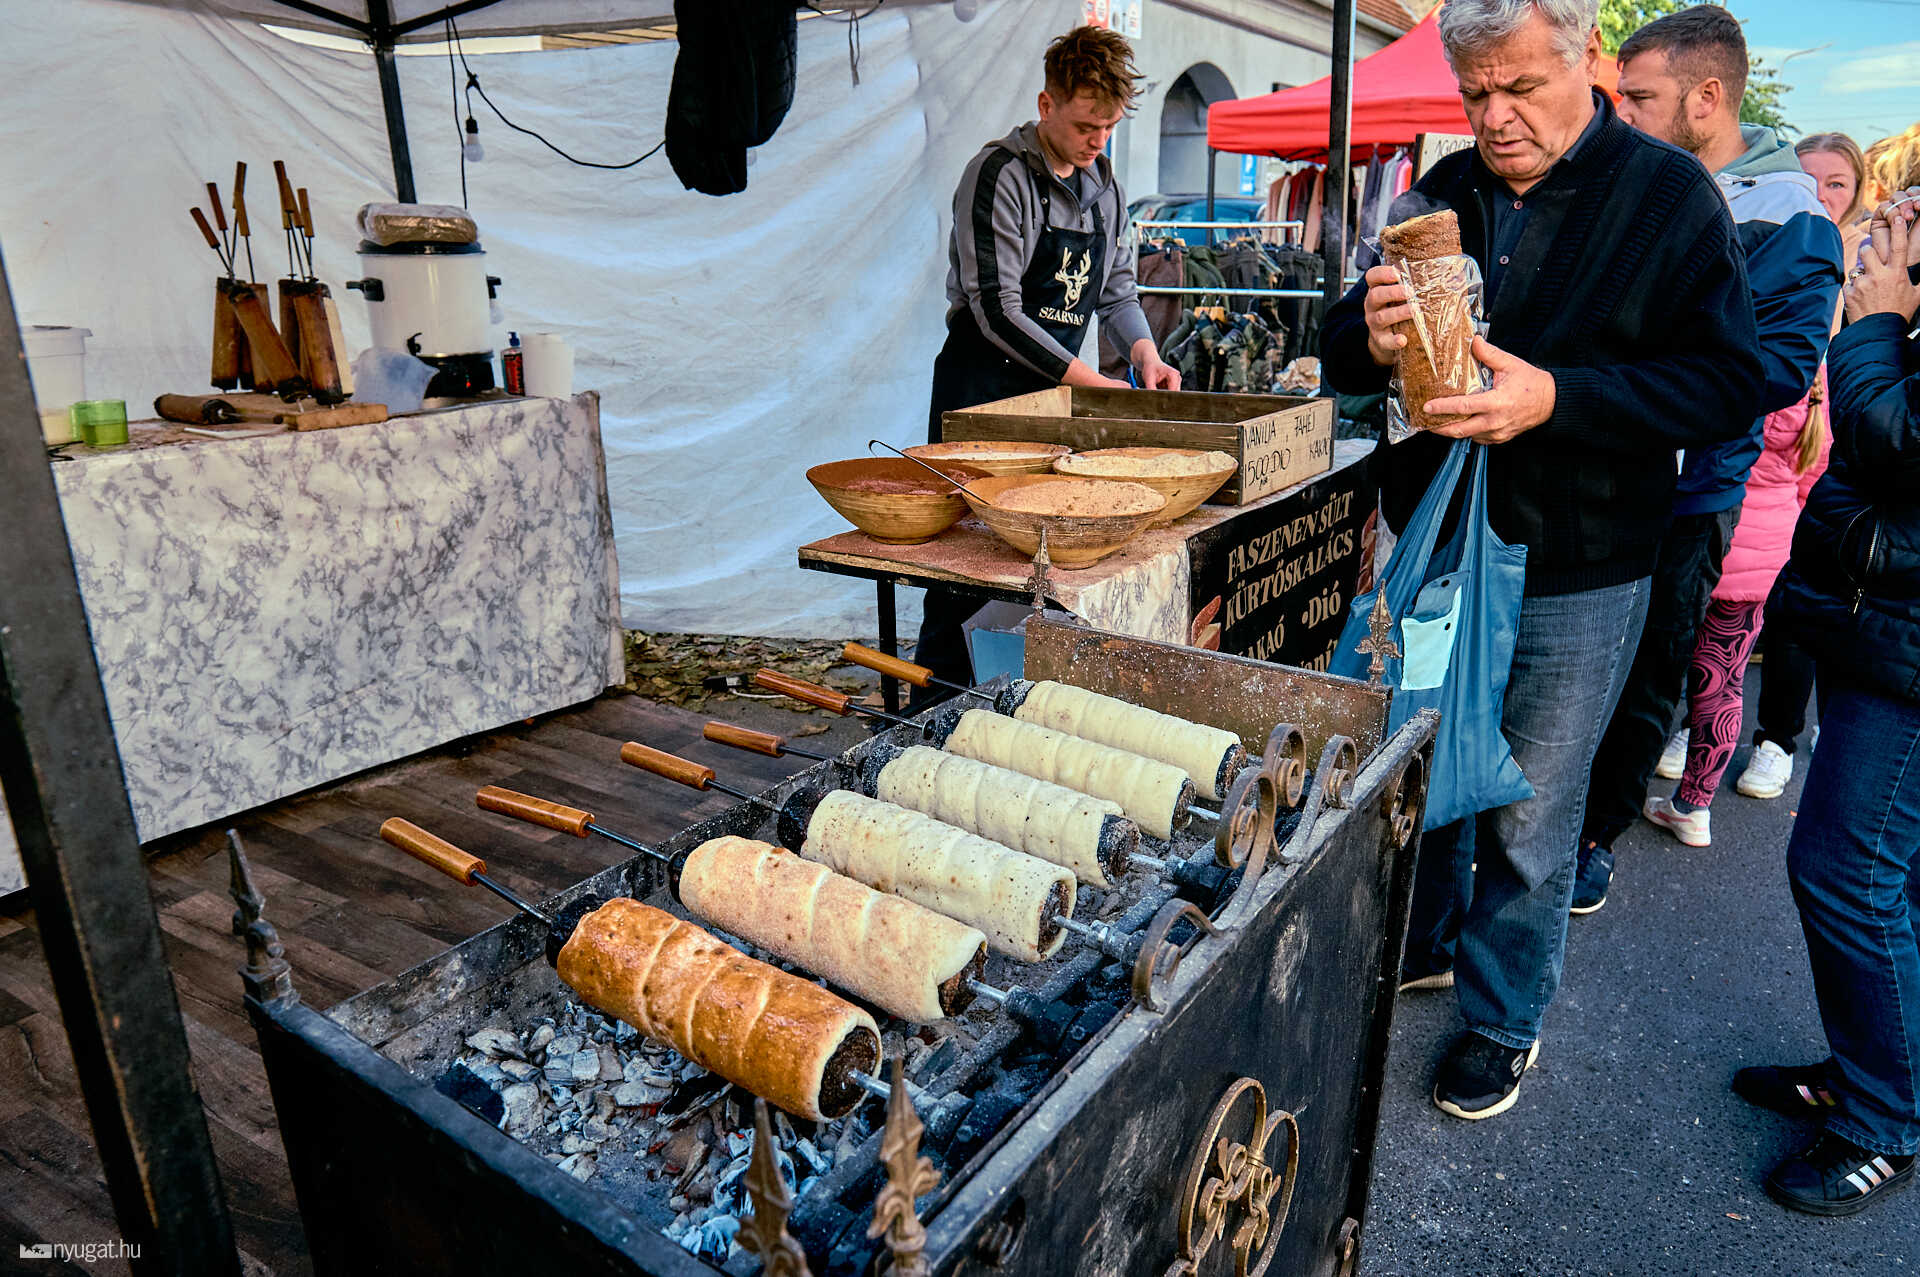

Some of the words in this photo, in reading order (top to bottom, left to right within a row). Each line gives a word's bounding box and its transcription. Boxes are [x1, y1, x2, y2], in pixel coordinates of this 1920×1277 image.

[1038, 306, 1085, 326] SZARVAS
[1224, 528, 1354, 632] KÜRTŐSKALÁCS
[1226, 510, 1320, 584] FASZENEN
[1318, 490, 1354, 534] SÜLT
